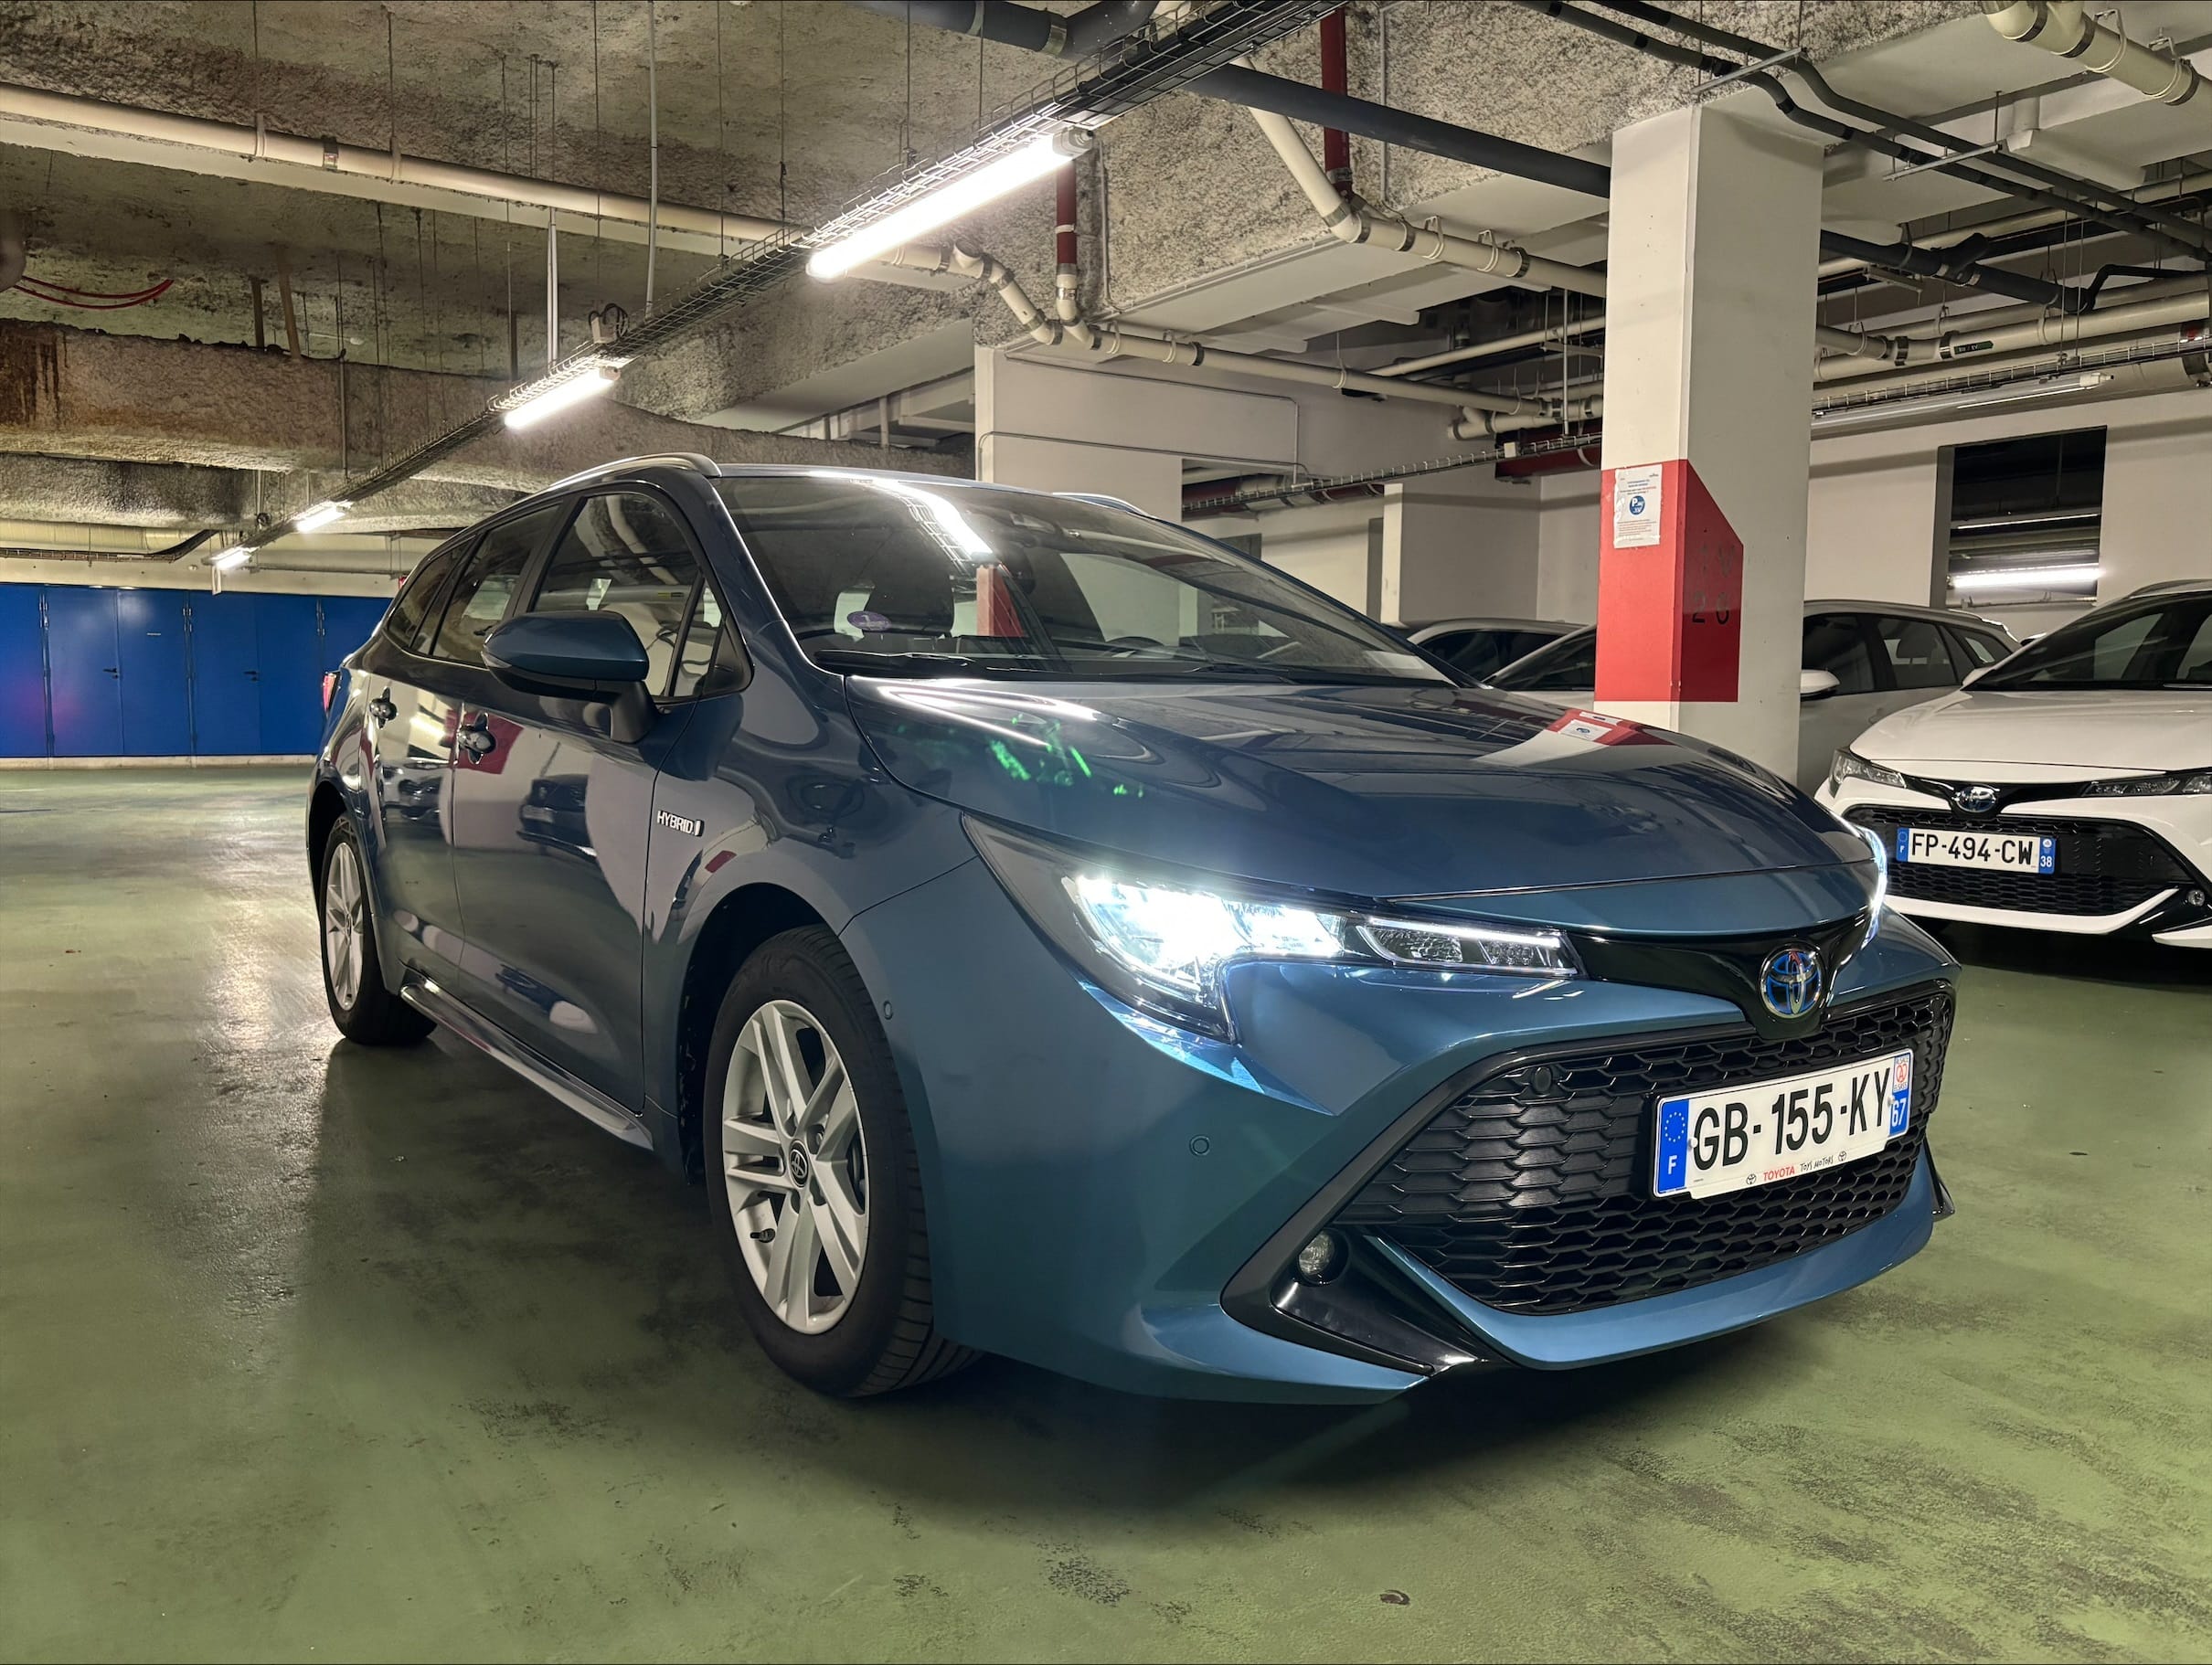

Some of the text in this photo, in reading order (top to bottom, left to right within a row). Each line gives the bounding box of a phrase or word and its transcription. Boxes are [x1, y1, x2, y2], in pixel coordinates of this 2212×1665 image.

[656, 810, 694, 834] HYBRID
[1911, 832, 2033, 865] FP-494-CW
[2040, 855, 2053, 867] 38
[1693, 1067, 1890, 1171] GB-155-KY
[1891, 1098, 1907, 1127] 67
[1668, 1155, 1678, 1174] F
[1763, 1166, 1795, 1182] TOYOTA
